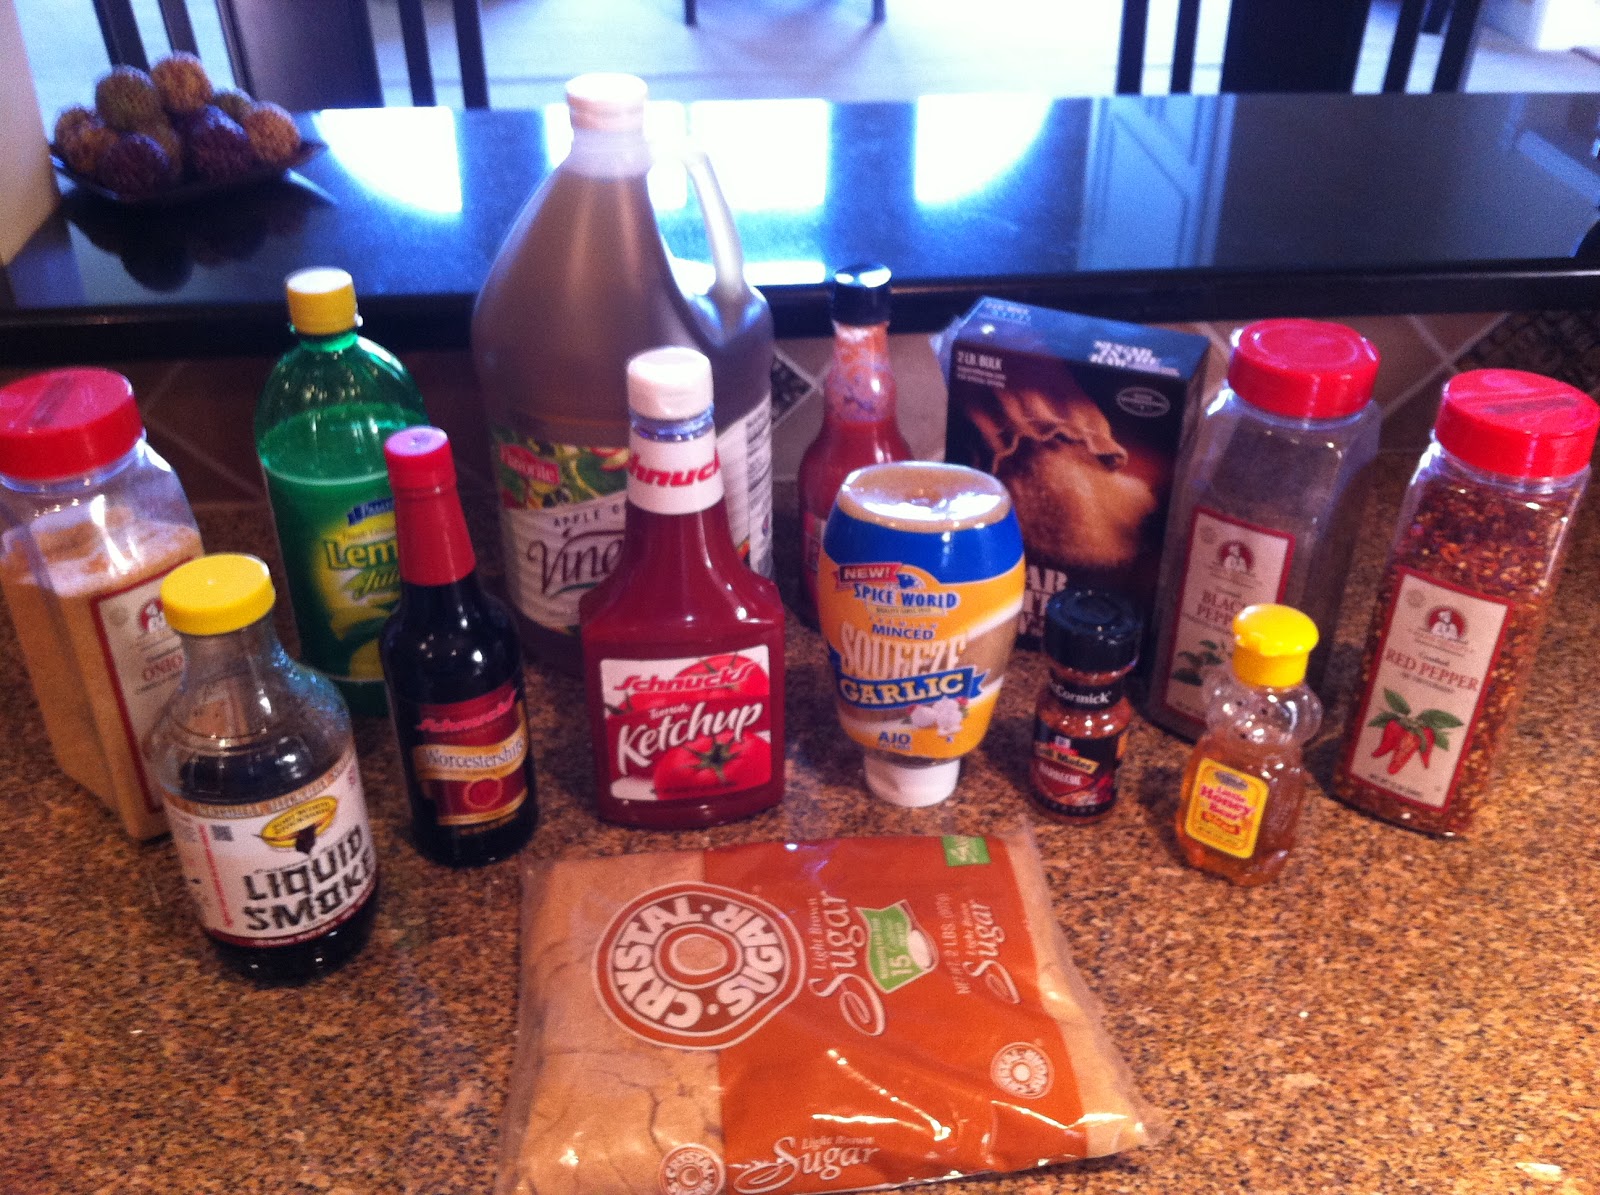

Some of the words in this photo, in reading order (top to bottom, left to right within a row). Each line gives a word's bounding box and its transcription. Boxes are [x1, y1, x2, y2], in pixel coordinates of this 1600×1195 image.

[553, 508, 600, 527] APPLE
[843, 566, 891, 580] NEW!
[854, 583, 893, 605] SPICE
[901, 592, 957, 609] WORLD
[841, 620, 967, 679] SQUEEZE
[872, 623, 934, 640] MINCED
[613, 662, 757, 693] Schnucks
[840, 672, 965, 704] GARLIC
[1385, 649, 1418, 674] RED
[1421, 660, 1480, 692] PEPPER
[617, 701, 764, 776] Ketchup
[878, 730, 912, 744] AJO
[243, 823, 364, 900] LIQUID
[243, 850, 376, 931] SMOKE
[613, 896, 704, 1028] CRYSTAL
[711, 903, 786, 1017] SUGAR
[808, 890, 886, 1037] Sugar
[888, 954, 914, 977] 15
[962, 899, 1021, 1004] Sugar
[733, 1136, 881, 1194] Sugar
